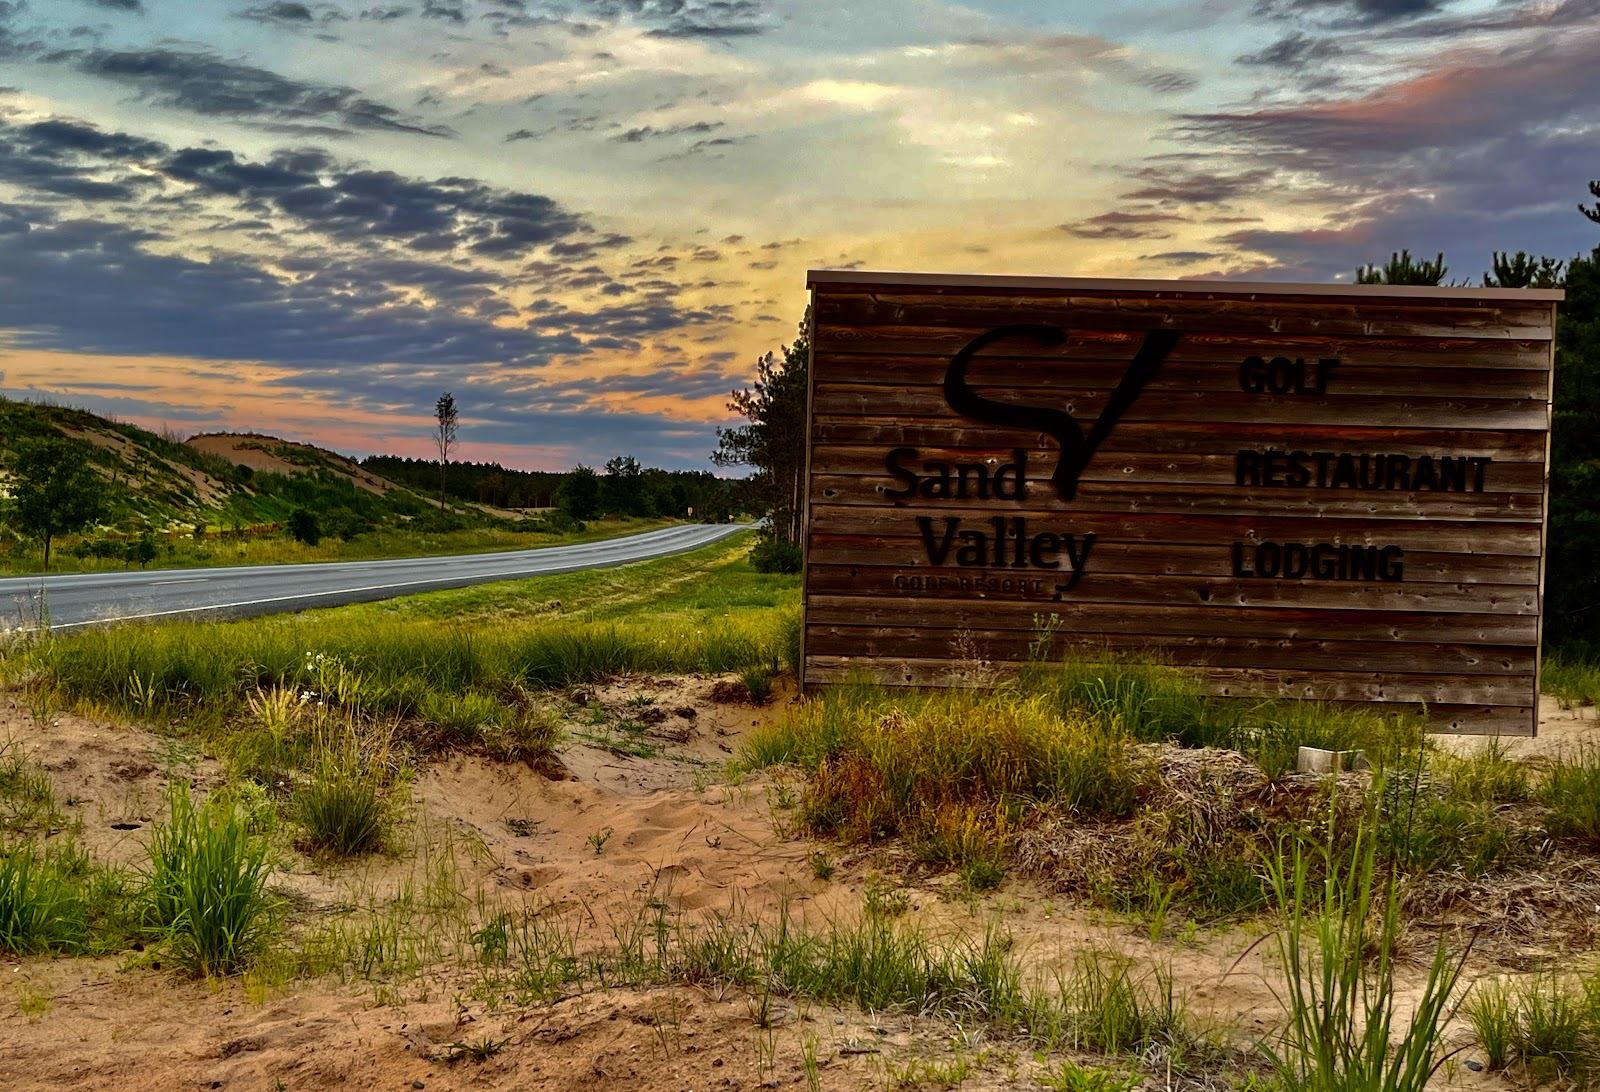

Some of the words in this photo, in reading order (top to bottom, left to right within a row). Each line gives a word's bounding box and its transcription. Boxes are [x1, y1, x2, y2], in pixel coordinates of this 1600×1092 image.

[1240, 357, 1339, 395] GOLF
[885, 447, 1026, 501] Sand
[1235, 450, 1492, 493] RESTAURANT
[916, 516, 1096, 601] Valley
[1232, 542, 1404, 582] LODGING
[894, 574, 948, 591] GOLF
[958, 576, 1045, 594] RESORT
